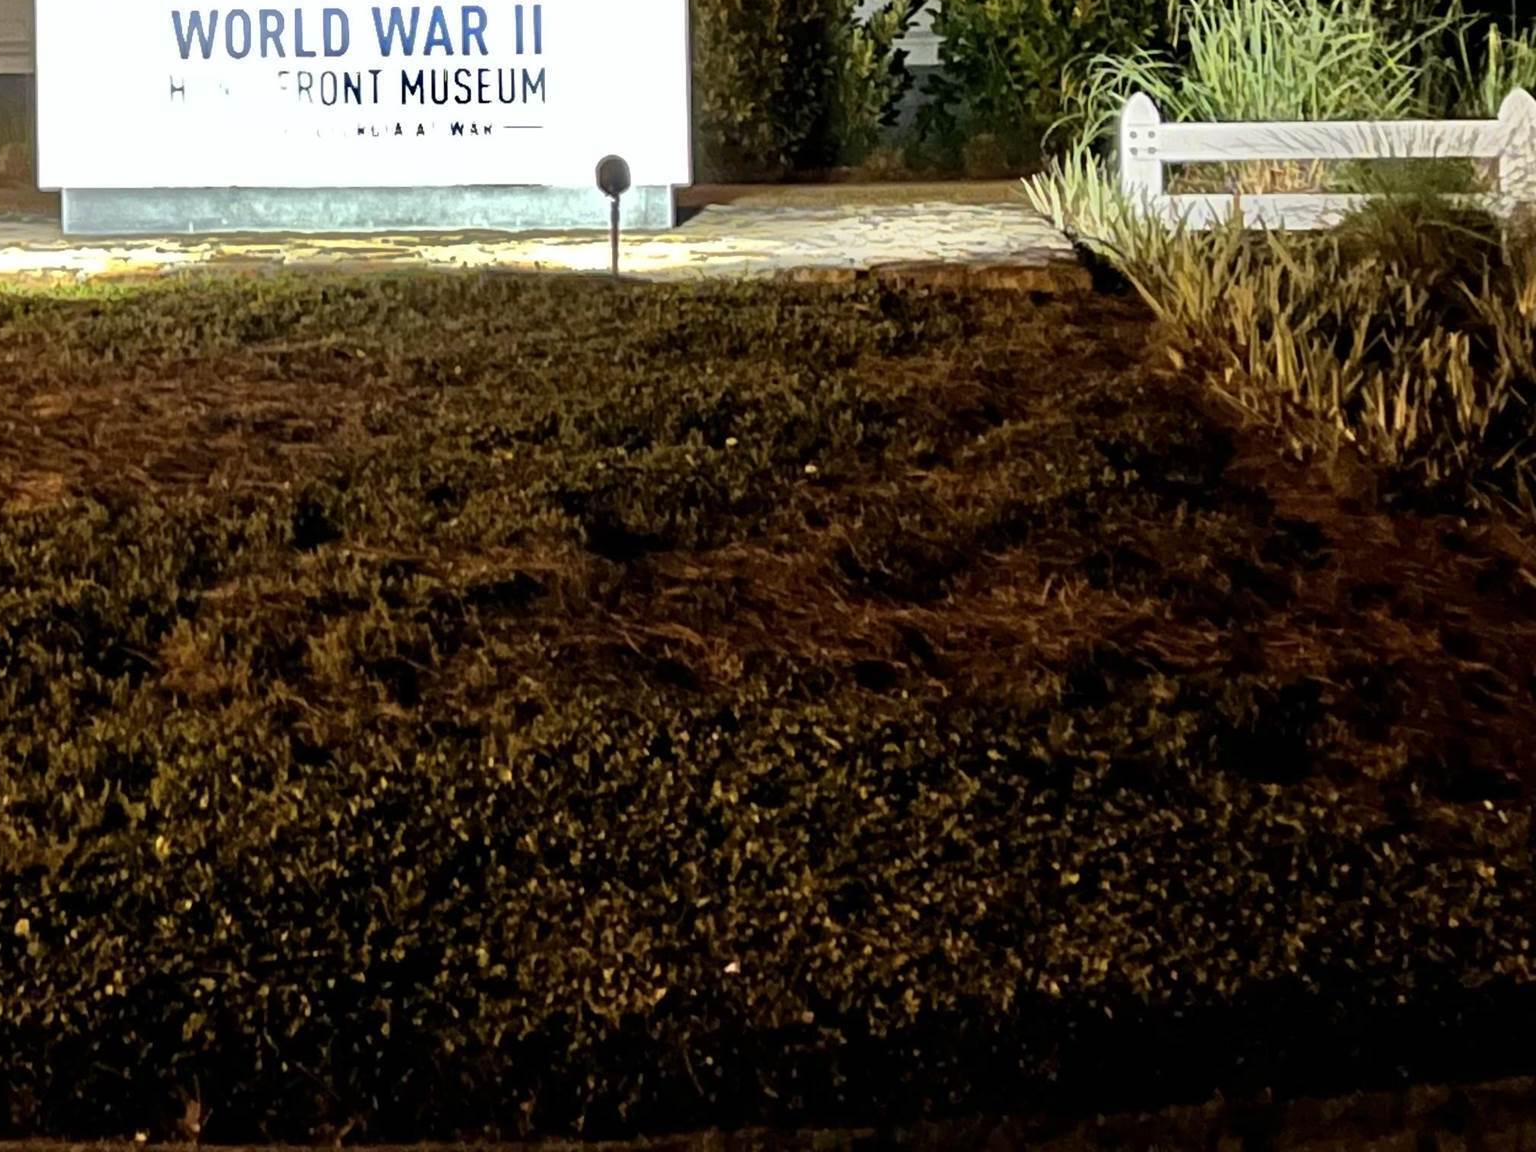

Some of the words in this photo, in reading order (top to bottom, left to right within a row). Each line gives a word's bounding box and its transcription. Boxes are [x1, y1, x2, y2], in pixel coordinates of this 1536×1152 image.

[170, 7, 352, 60] WORLD
[370, 4, 490, 58] WAR
[513, 3, 543, 56] II
[400, 66, 547, 106] MUSEUM
